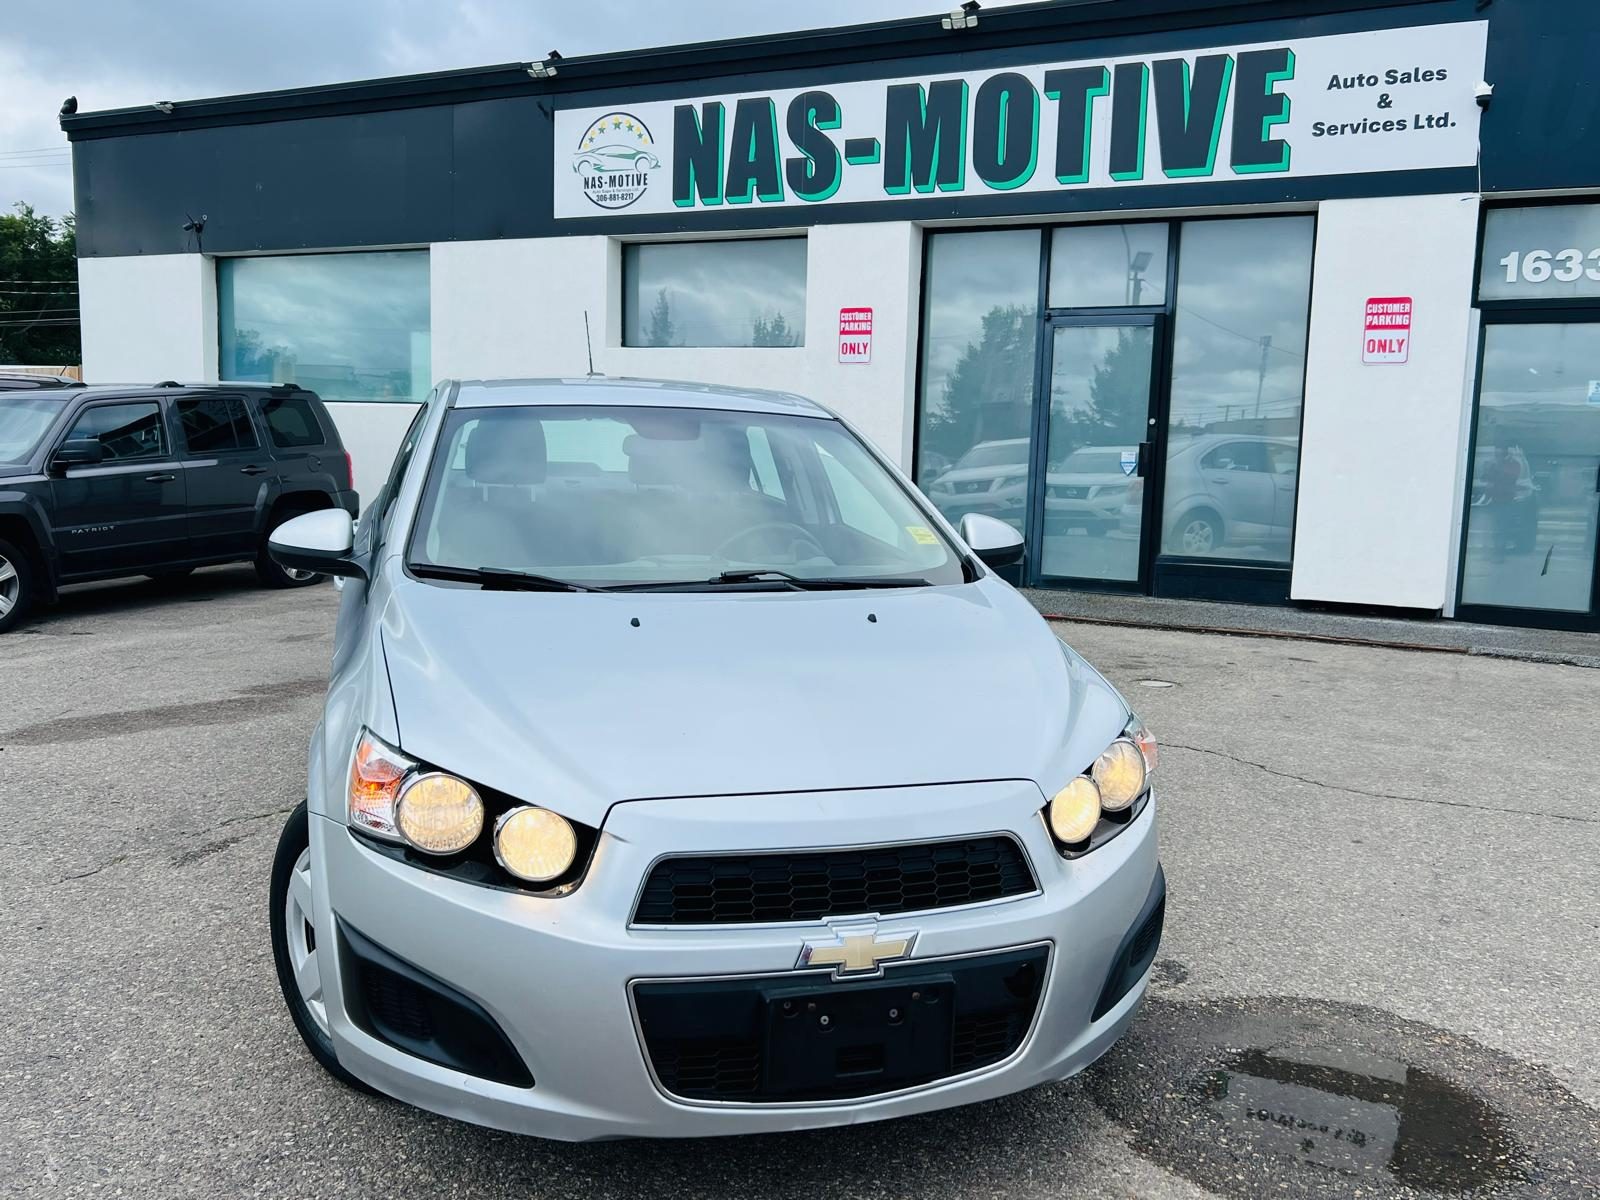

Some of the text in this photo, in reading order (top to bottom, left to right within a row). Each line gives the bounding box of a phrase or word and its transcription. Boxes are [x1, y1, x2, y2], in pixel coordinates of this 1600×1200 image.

[1327, 67, 1448, 90] Auto Sales
[1377, 93, 1393, 109] &
[673, 47, 1296, 208] NAS-MOTIVE
[1312, 112, 1457, 137] Services Ltd.
[584, 173, 647, 189] NAS-MOTIVE
[1367, 303, 1410, 313] CUSTOMER
[841, 322, 871, 331] PARKING
[1366, 315, 1409, 325] PARKING
[842, 342, 868, 354] ONLY
[1367, 339, 1405, 353] ONLY
[72, 526, 114, 534] PATRIOT
